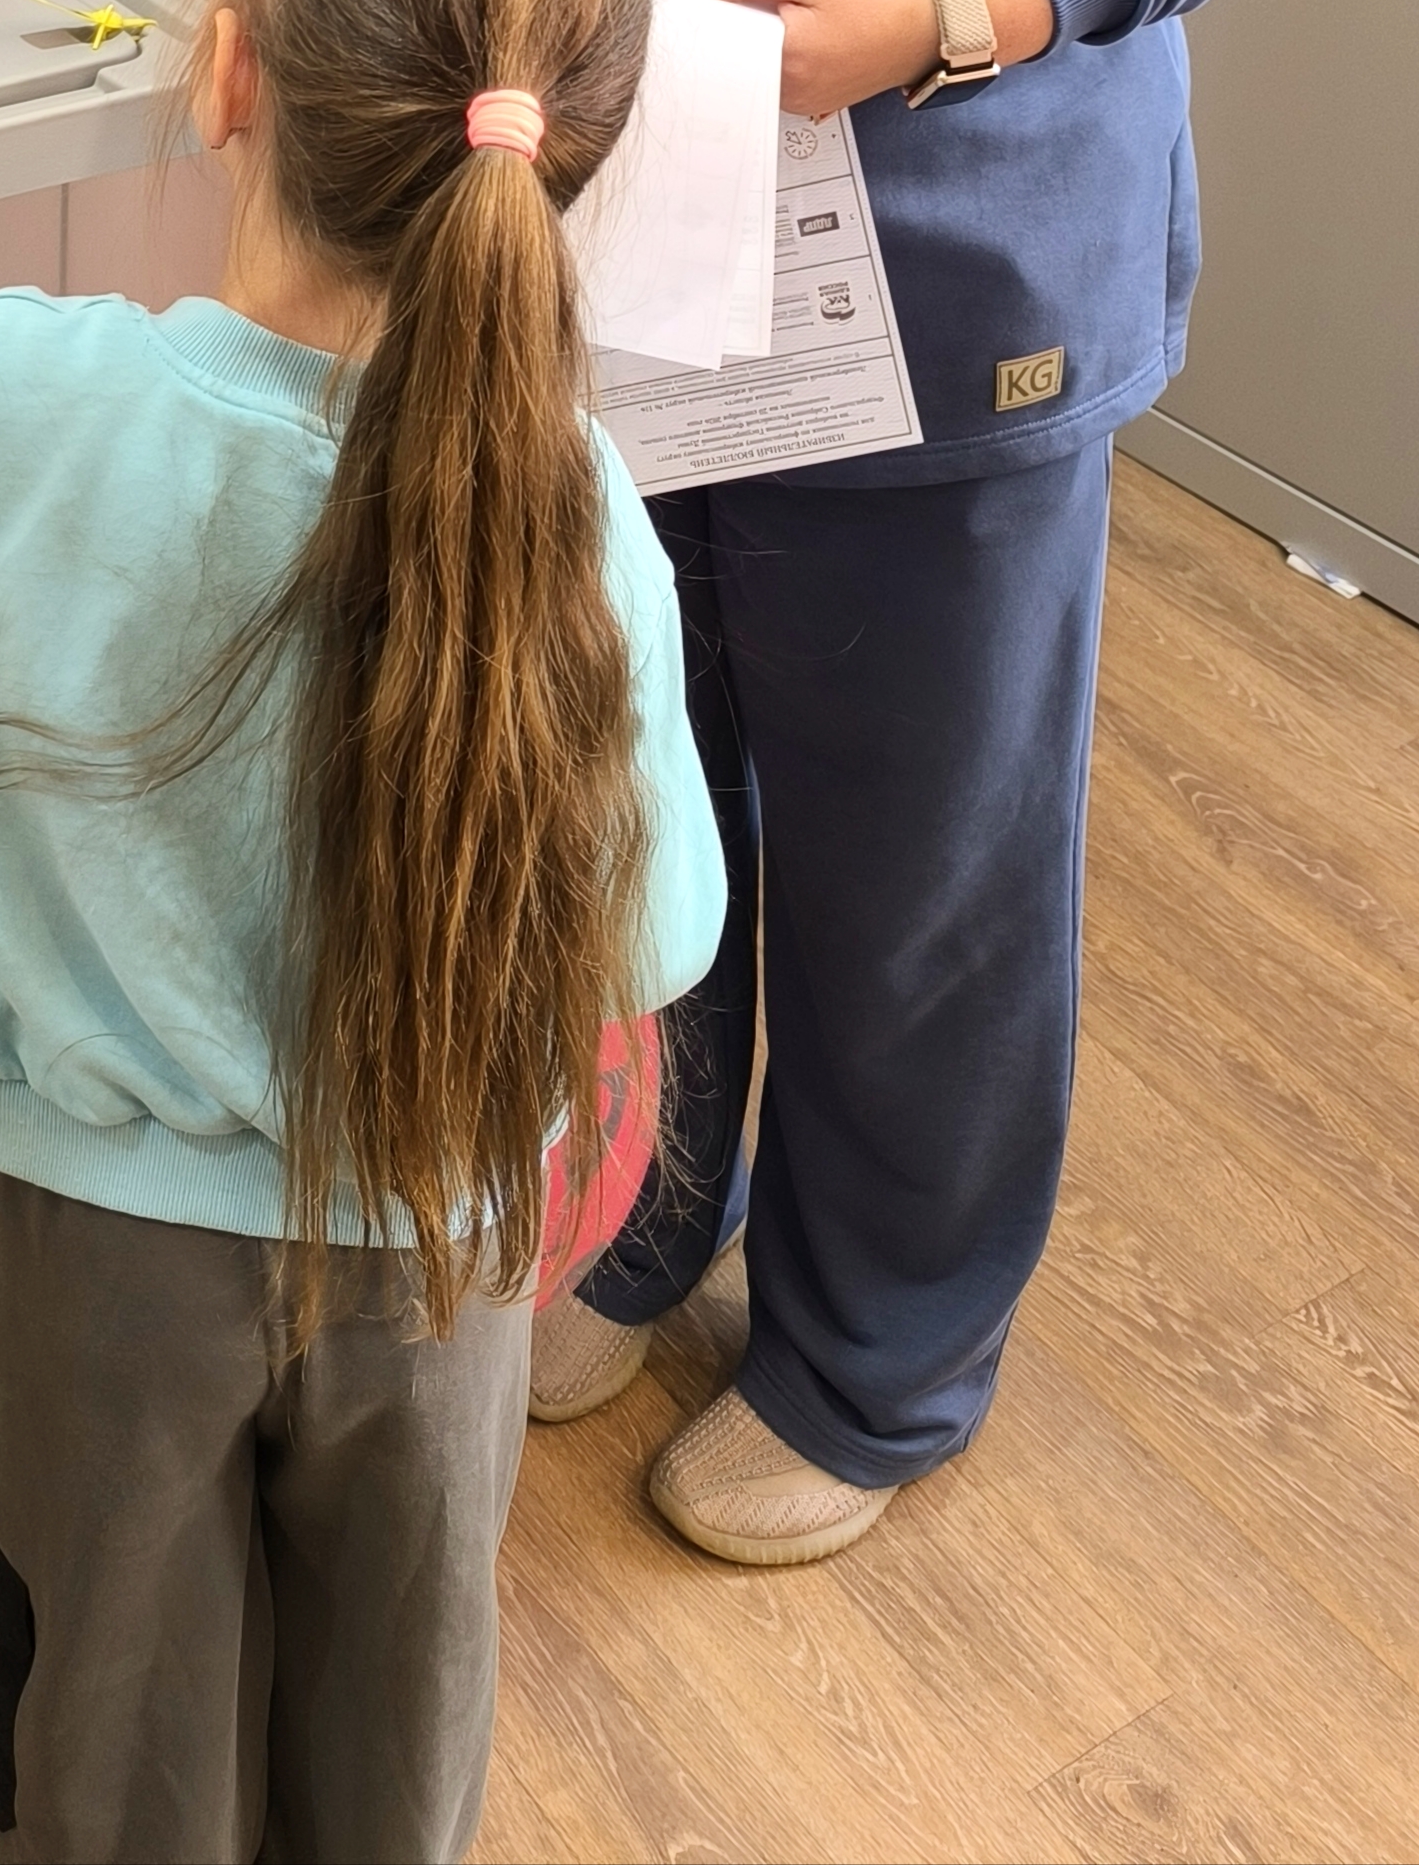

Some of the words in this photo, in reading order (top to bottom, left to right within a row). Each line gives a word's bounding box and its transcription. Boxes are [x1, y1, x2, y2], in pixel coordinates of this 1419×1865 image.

[803, 216, 833, 233] ЛДПР
[1007, 358, 1053, 401] KG
[756, 432, 844, 457] ИЗБИРАТЕЛЬНЫЙ
[688, 449, 754, 469] БЮЛЛЕТЕНЬ
